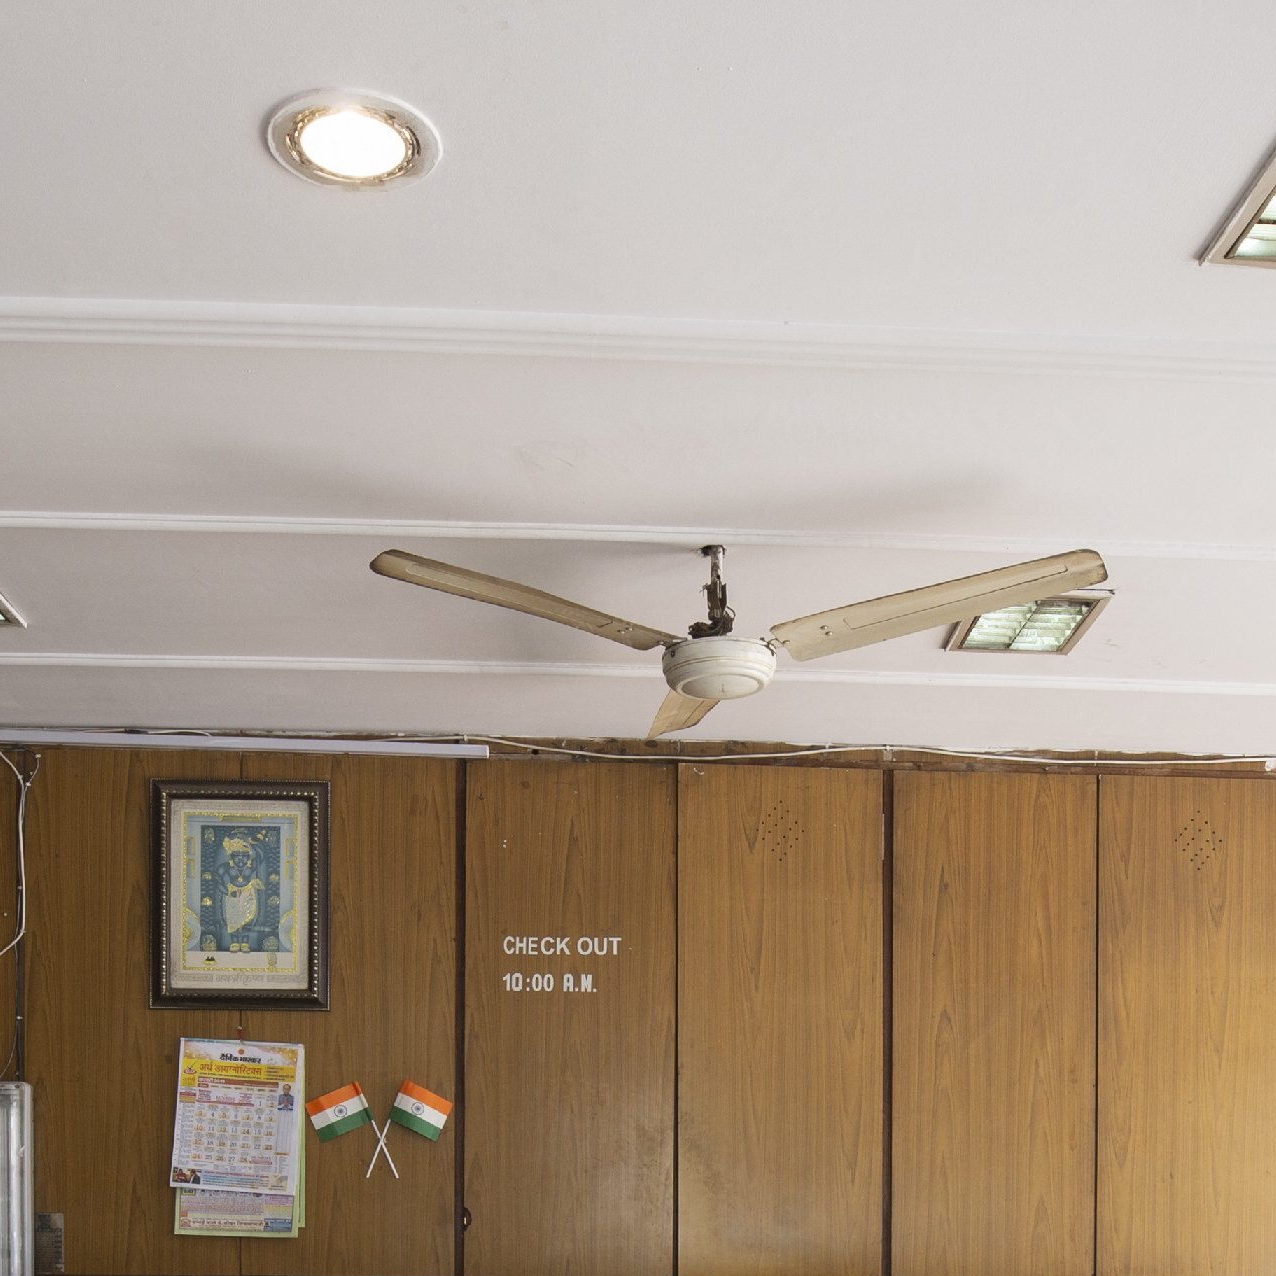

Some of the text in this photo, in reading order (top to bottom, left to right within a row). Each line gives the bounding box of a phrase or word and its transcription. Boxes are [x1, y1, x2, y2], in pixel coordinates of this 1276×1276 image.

[503, 936, 622, 955] CHECK OUT
[503, 972, 555, 992] 10:00
